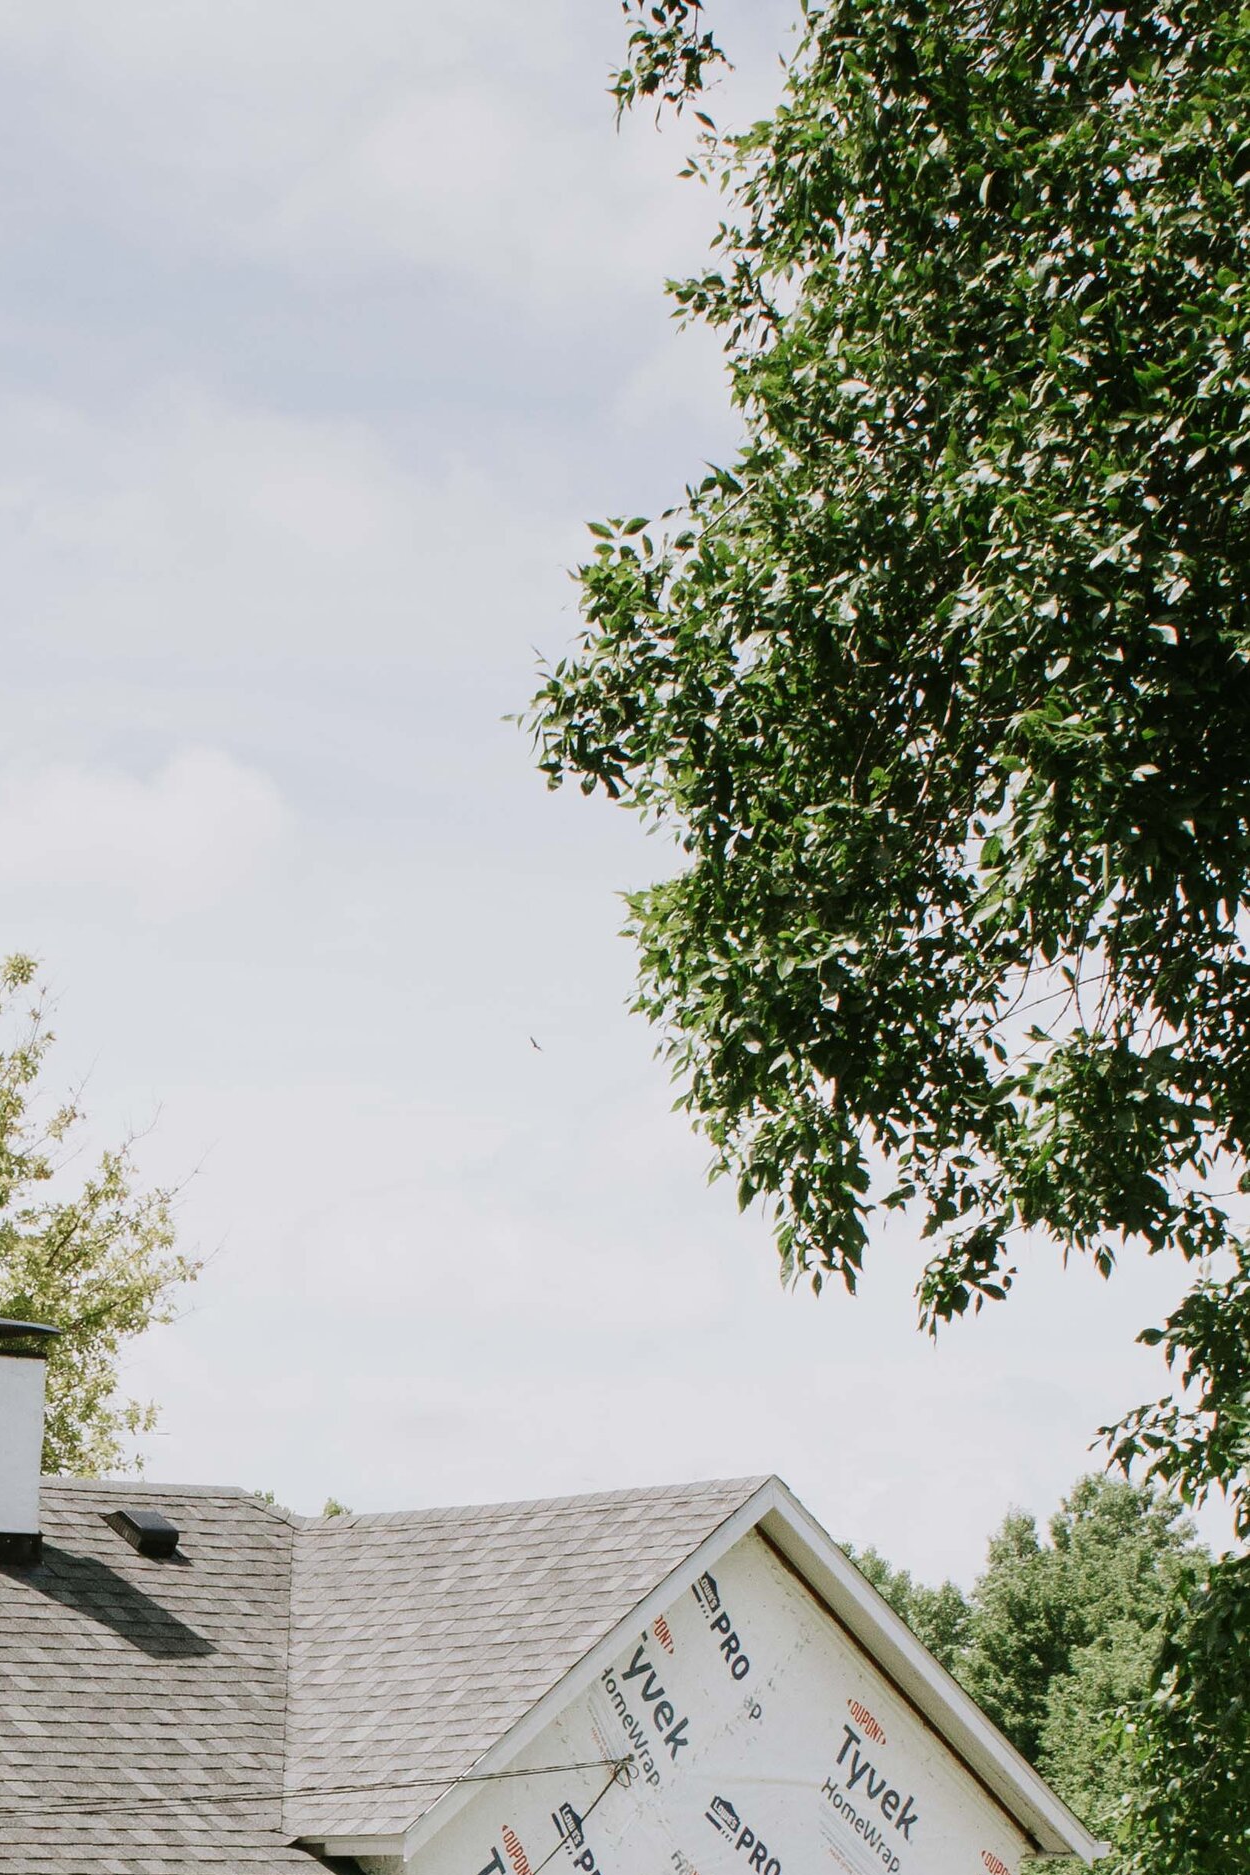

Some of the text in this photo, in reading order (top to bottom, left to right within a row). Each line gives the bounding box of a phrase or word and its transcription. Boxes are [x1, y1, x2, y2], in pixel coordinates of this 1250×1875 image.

[710, 1611, 749, 1680] PRO
[621, 1631, 689, 1760] yvek
[850, 1701, 885, 1745] DUPONT
[821, 1777, 900, 1874] HomeWrap
[836, 1723, 918, 1840] Tyvek
